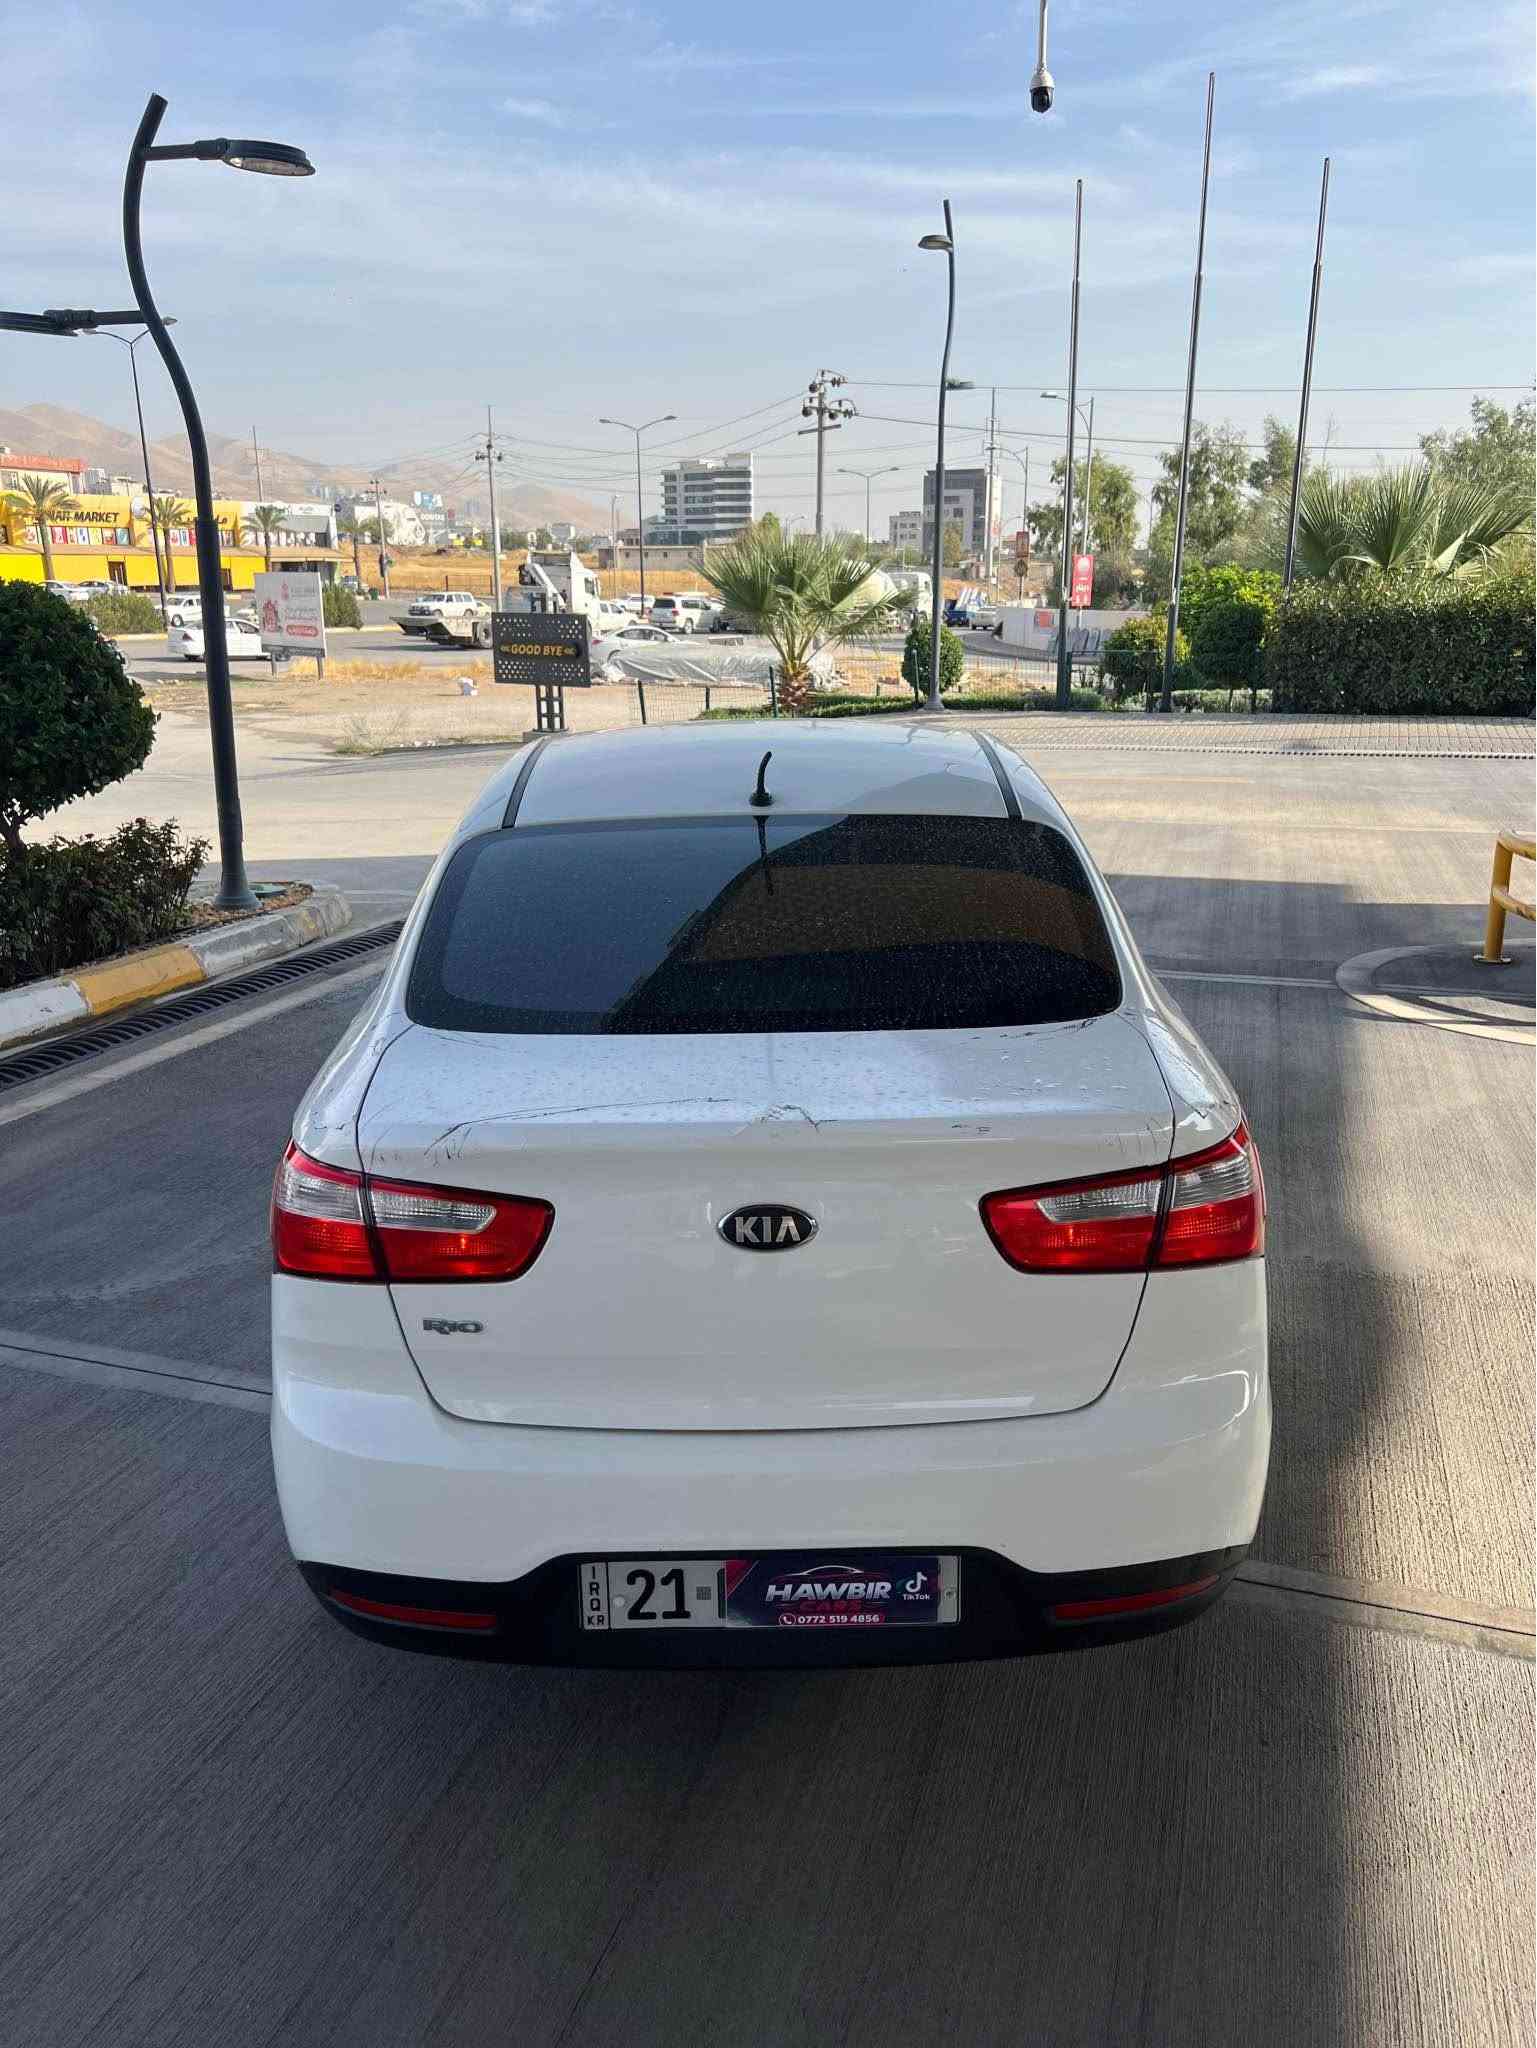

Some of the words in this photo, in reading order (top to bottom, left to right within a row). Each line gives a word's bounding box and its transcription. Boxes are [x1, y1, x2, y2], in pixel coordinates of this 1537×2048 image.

[73, 511, 120, 523] MARKET
[511, 643, 541, 655] GOOD
[543, 645, 562, 656] BYE
[735, 1216, 801, 1243] KIA
[423, 1318, 484, 1335] RIO
[626, 1568, 691, 1620] 21
[765, 1581, 892, 1602] HAWBIR
[902, 1592, 930, 1601] TikTok
[587, 1615, 604, 1626] KR
[798, 1615, 826, 1624] 0772
[828, 1615, 848, 1623] 519
[850, 1614, 880, 1623] 4856
